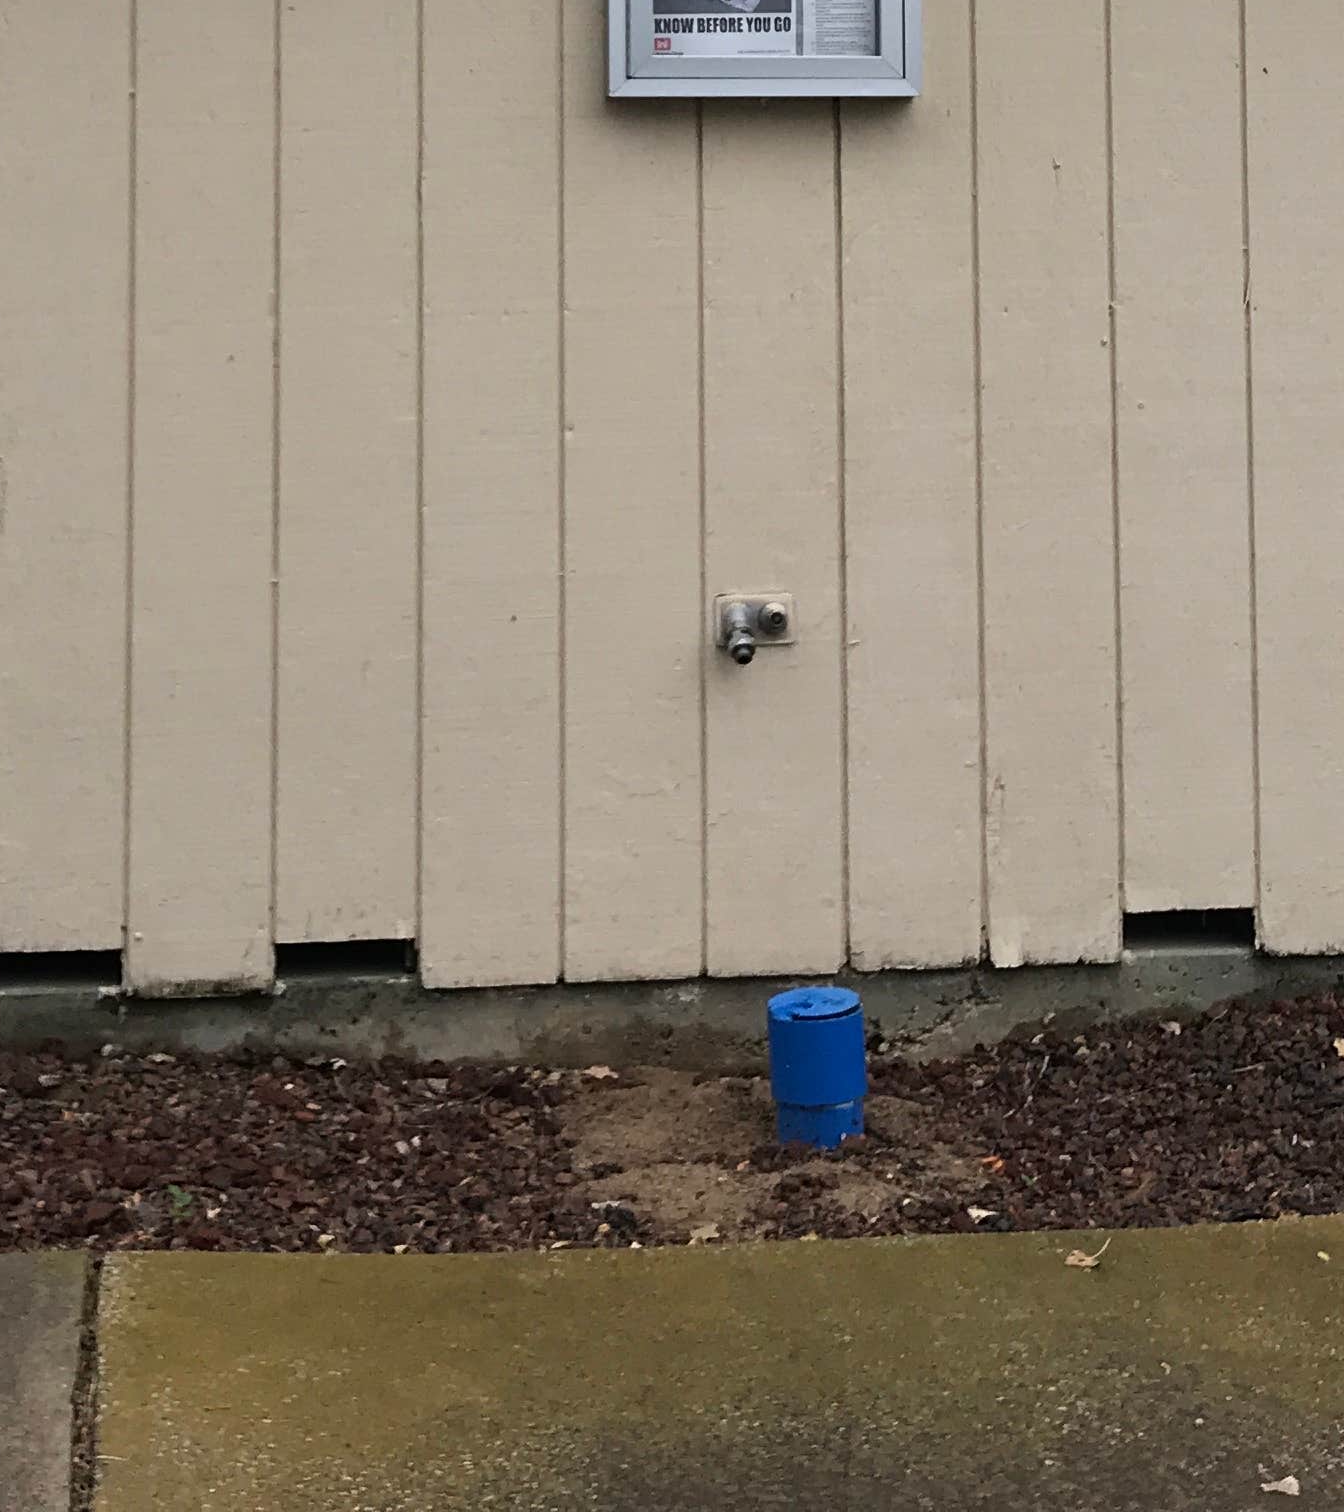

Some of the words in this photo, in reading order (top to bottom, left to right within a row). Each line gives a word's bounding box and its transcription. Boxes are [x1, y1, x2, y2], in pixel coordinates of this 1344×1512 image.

[654, 17, 694, 34] KNOW
[697, 17, 743, 33] BEFORE
[746, 16, 771, 33] YOU
[774, 16, 792, 32] GO
